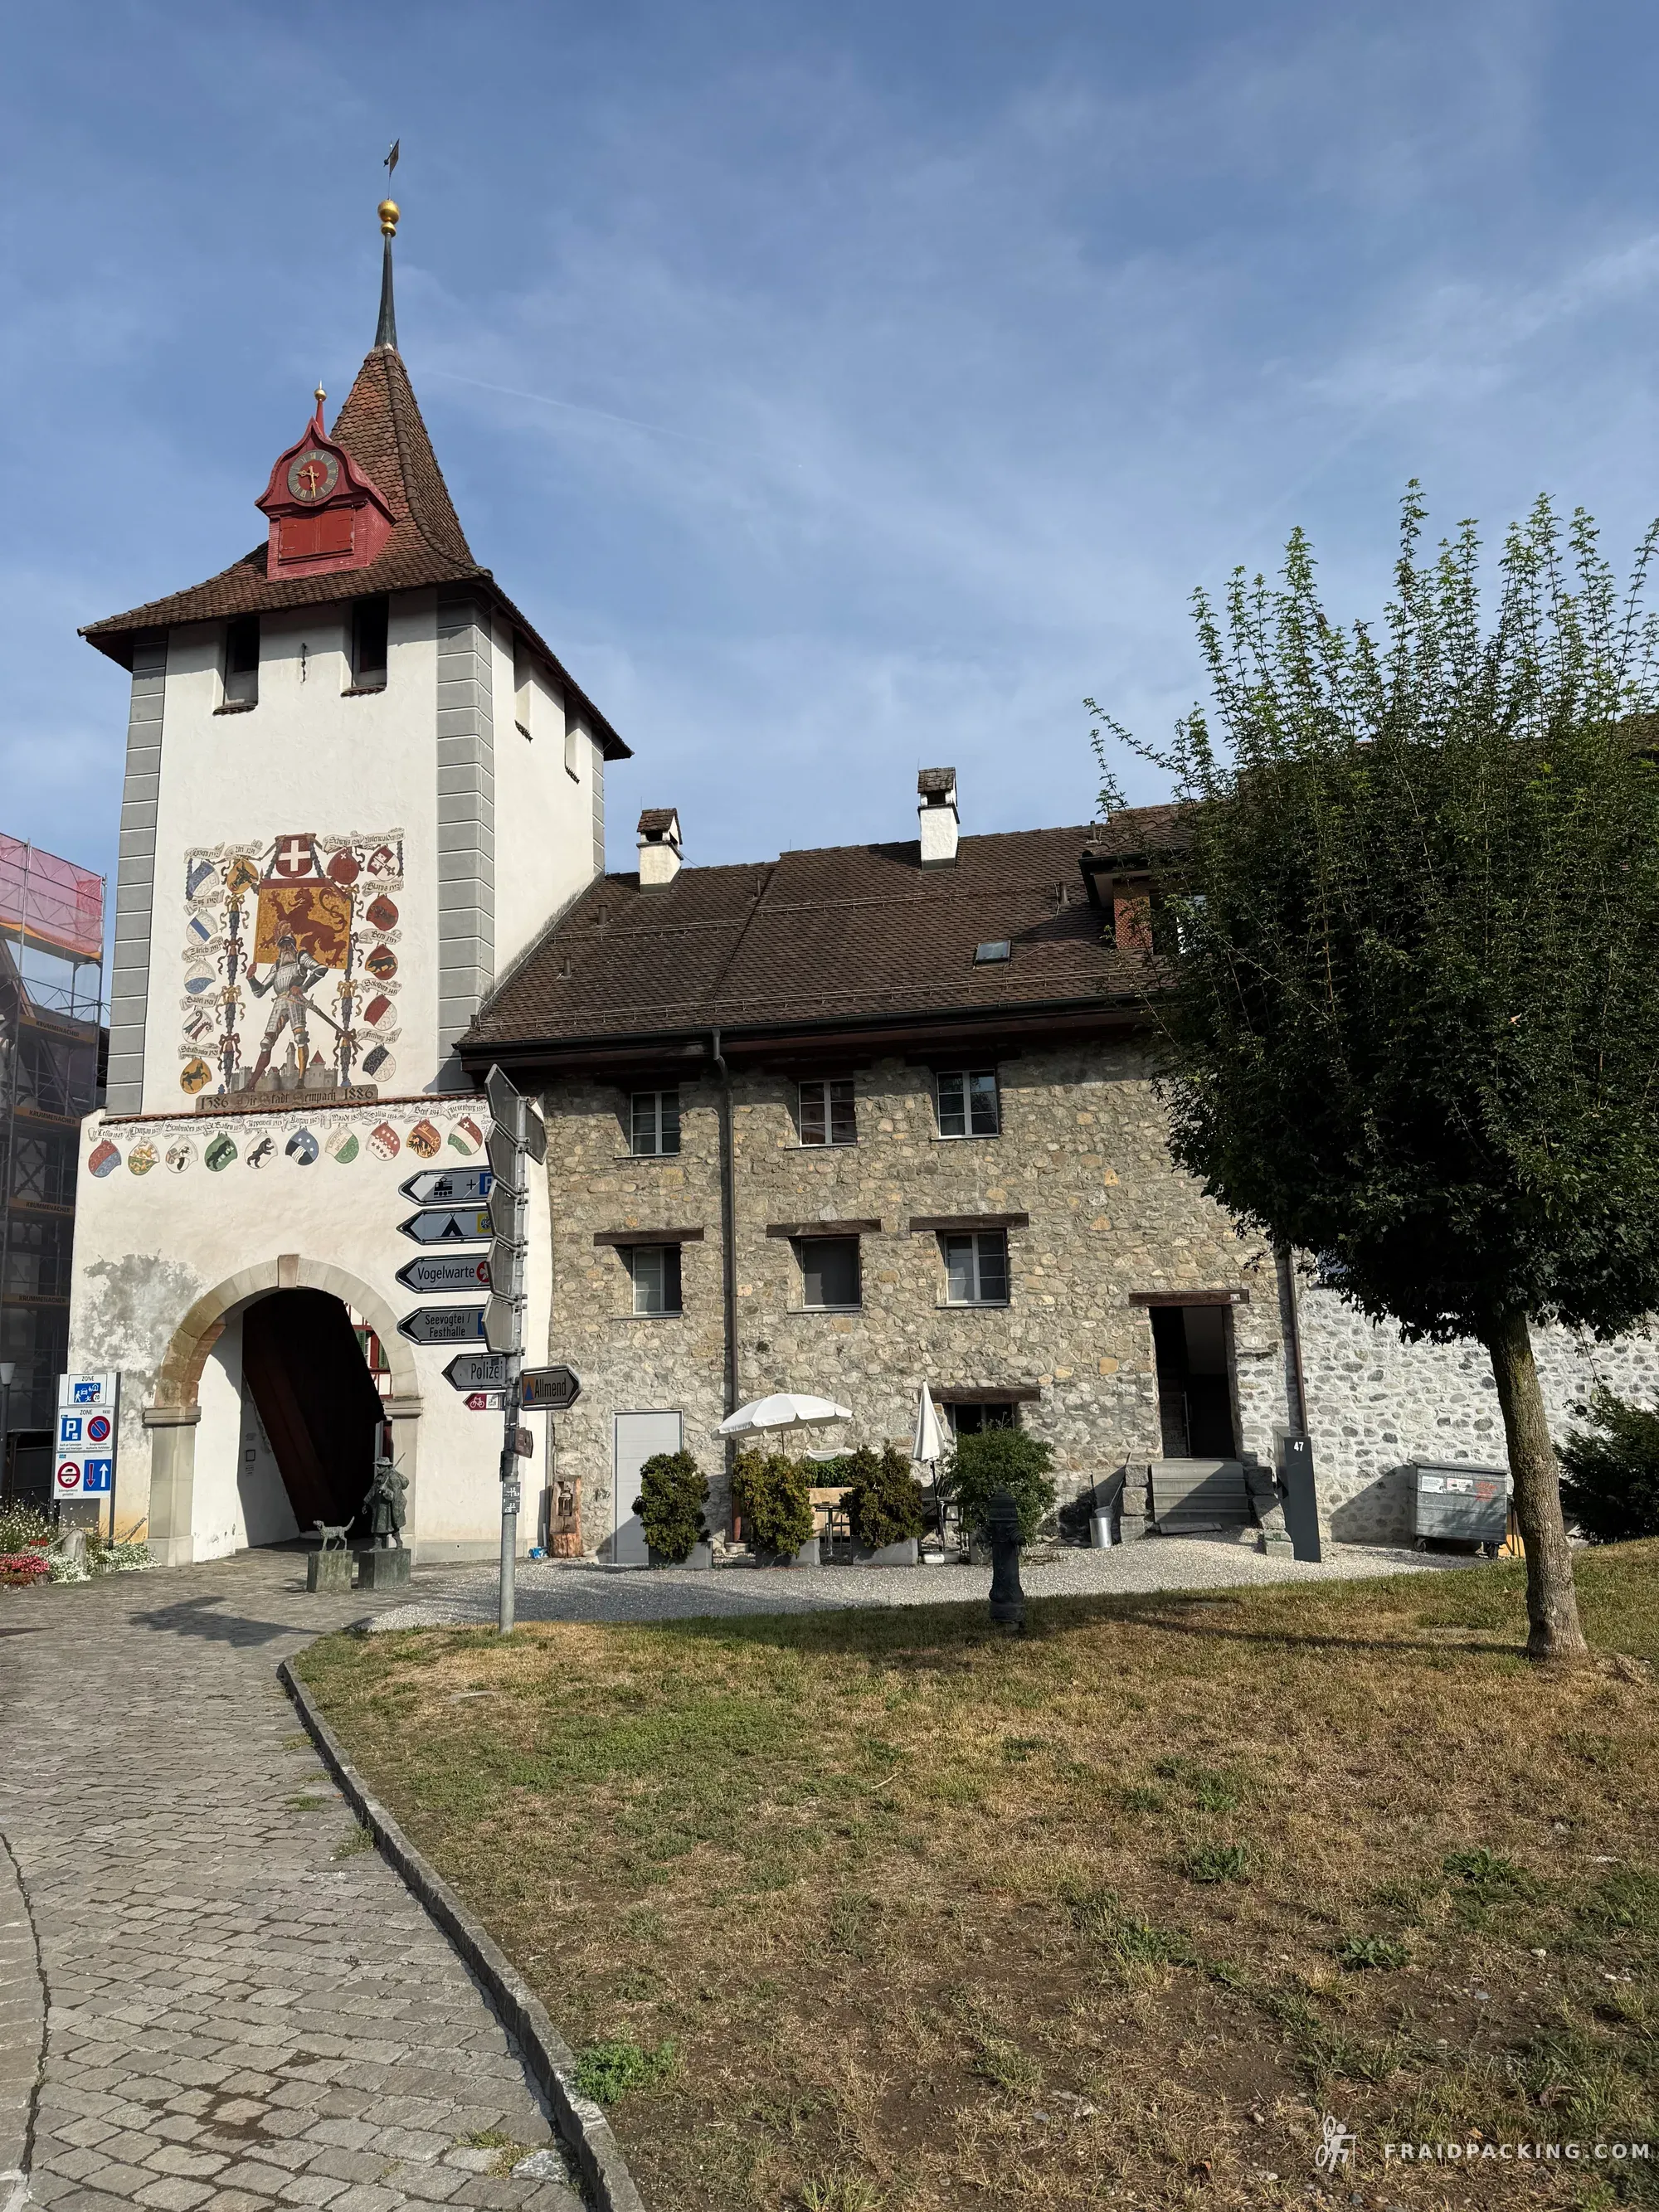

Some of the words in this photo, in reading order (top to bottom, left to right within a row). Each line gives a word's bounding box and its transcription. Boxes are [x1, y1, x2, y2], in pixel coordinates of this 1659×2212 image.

[200, 1096, 229, 1110] 1386
[343, 1087, 373, 1101] 1886
[417, 1266, 474, 1283] Vogelwarte
[425, 1314, 465, 1327] Seevogtei
[430, 1326, 465, 1337] Festhalle
[470, 1360, 503, 1380] Polizei
[534, 1378, 566, 1398] Allmend
[66, 1420, 76, 1437] P
[1294, 1441, 1304, 1451] 47
